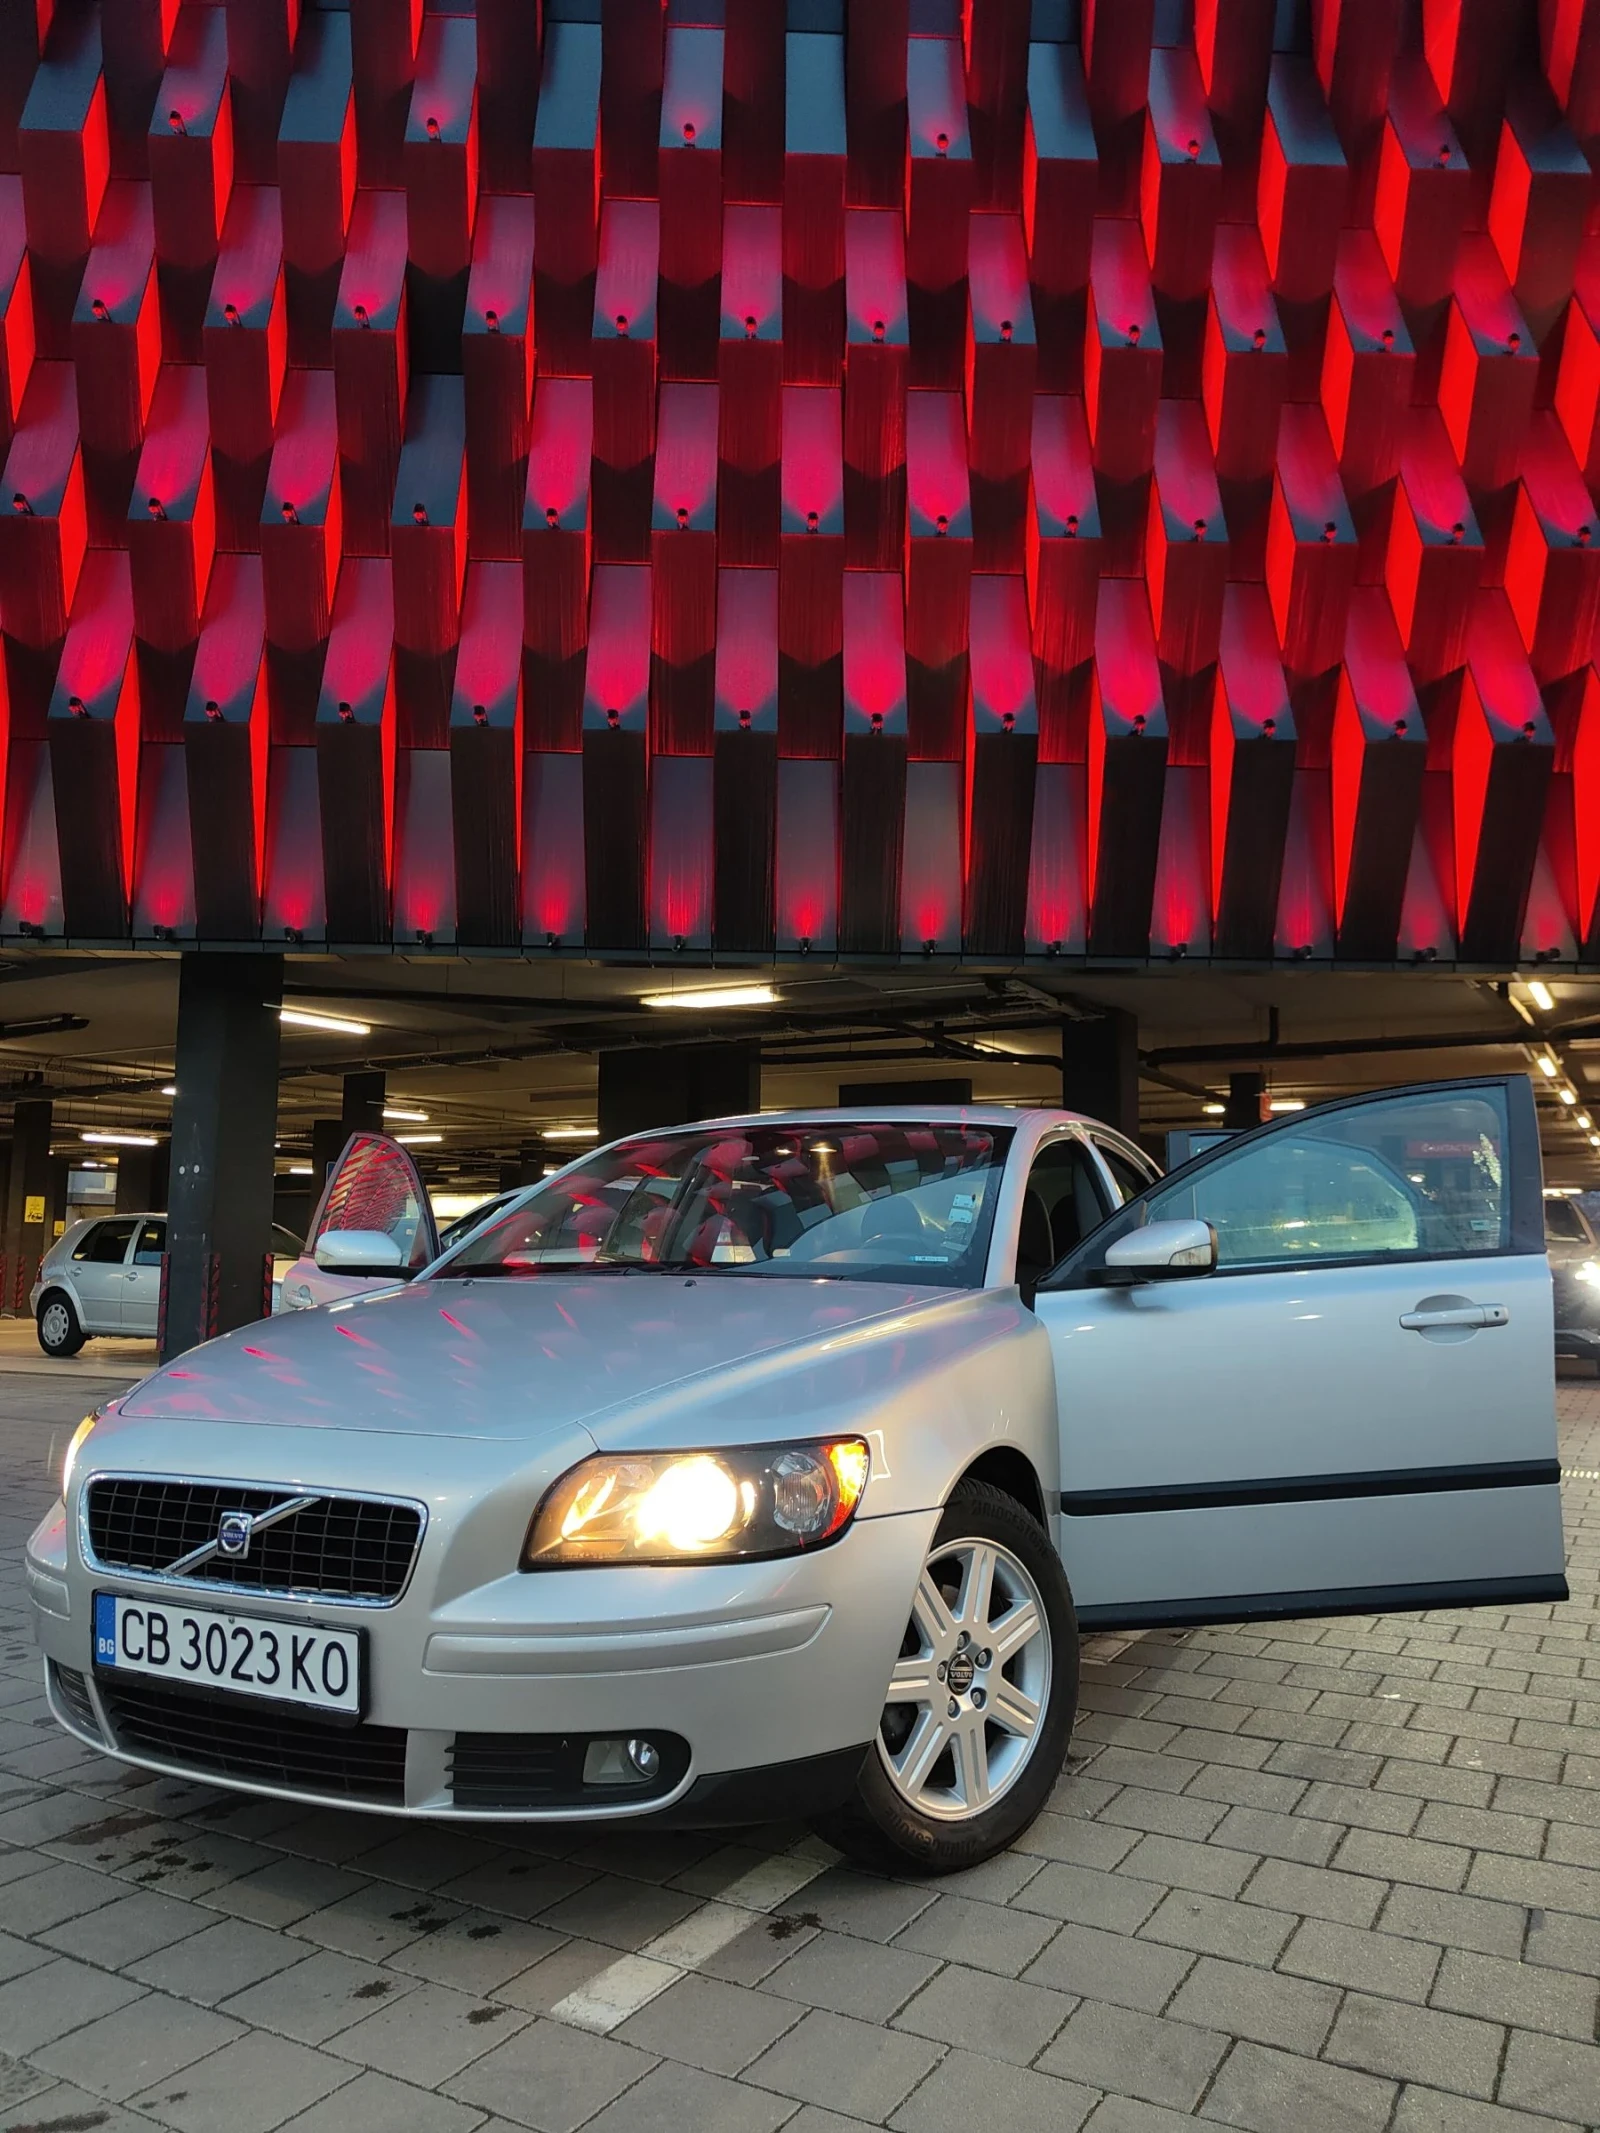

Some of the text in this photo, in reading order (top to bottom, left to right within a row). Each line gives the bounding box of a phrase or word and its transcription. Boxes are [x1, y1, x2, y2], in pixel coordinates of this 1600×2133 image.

[222, 1531, 244, 1539] VOLVO
[99, 1637, 114, 1655] BG
[122, 1609, 170, 1665] CB
[180, 1618, 280, 1685] 3023
